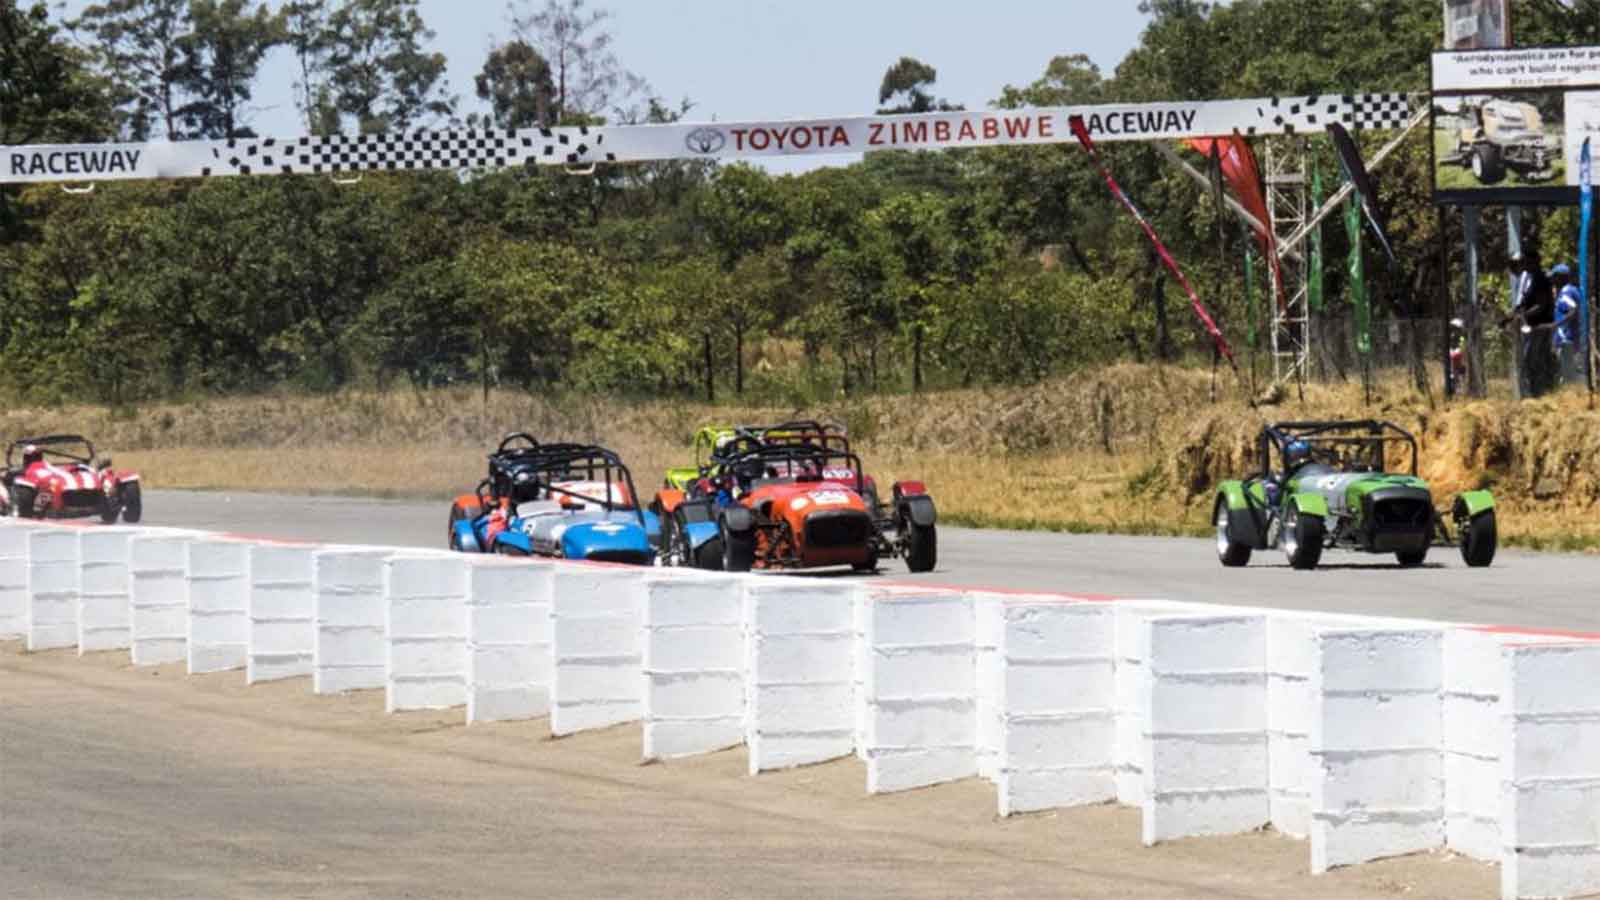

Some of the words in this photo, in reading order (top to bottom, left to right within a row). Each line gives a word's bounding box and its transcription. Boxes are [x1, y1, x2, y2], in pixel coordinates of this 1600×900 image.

[730, 125, 850, 151] TOYOTA
[867, 115, 1055, 145] ZIMBABWE
[10, 149, 141, 175] RACEWAY
